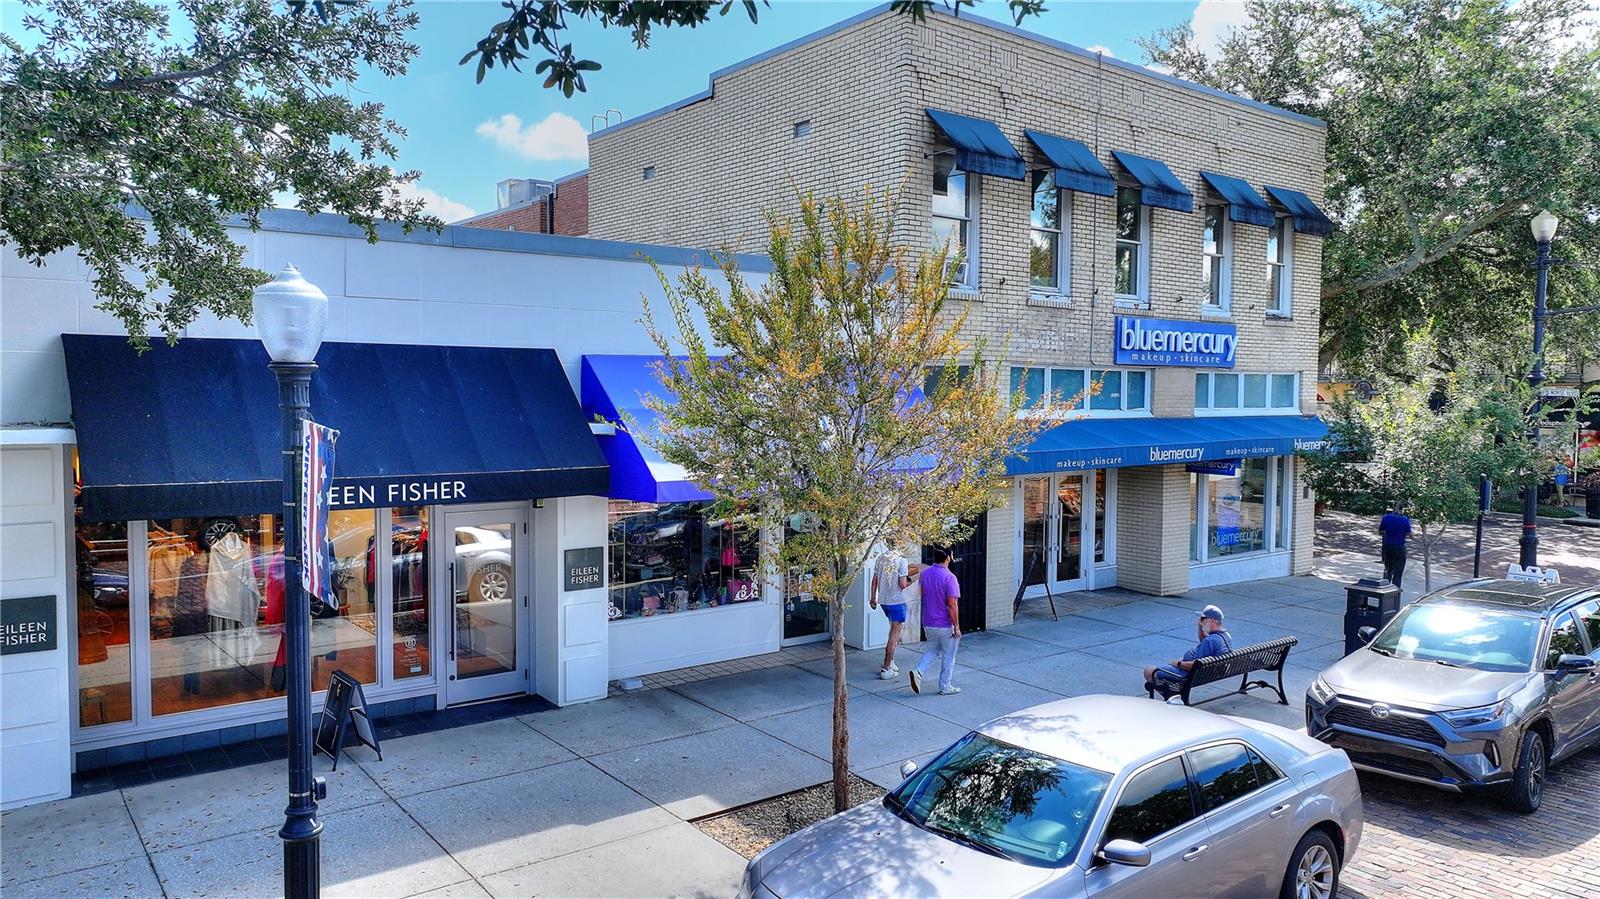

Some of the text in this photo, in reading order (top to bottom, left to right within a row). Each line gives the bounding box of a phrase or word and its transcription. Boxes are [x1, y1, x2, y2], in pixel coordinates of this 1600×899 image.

[1121, 318, 1239, 362] bluemercury
[1131, 352, 1221, 364] makeup skincare
[1150, 446, 1204, 461] bluemercury
[1225, 446, 1275, 456] makeup skincare
[1056, 456, 1122, 469] makeup skincare
[303, 434, 312, 521] WINTER
[329, 480, 467, 506] EEN FISHER
[571, 566, 599, 576] EILEEN
[571, 574, 599, 585] FISHER
[0, 621, 47, 635] EILEEN
